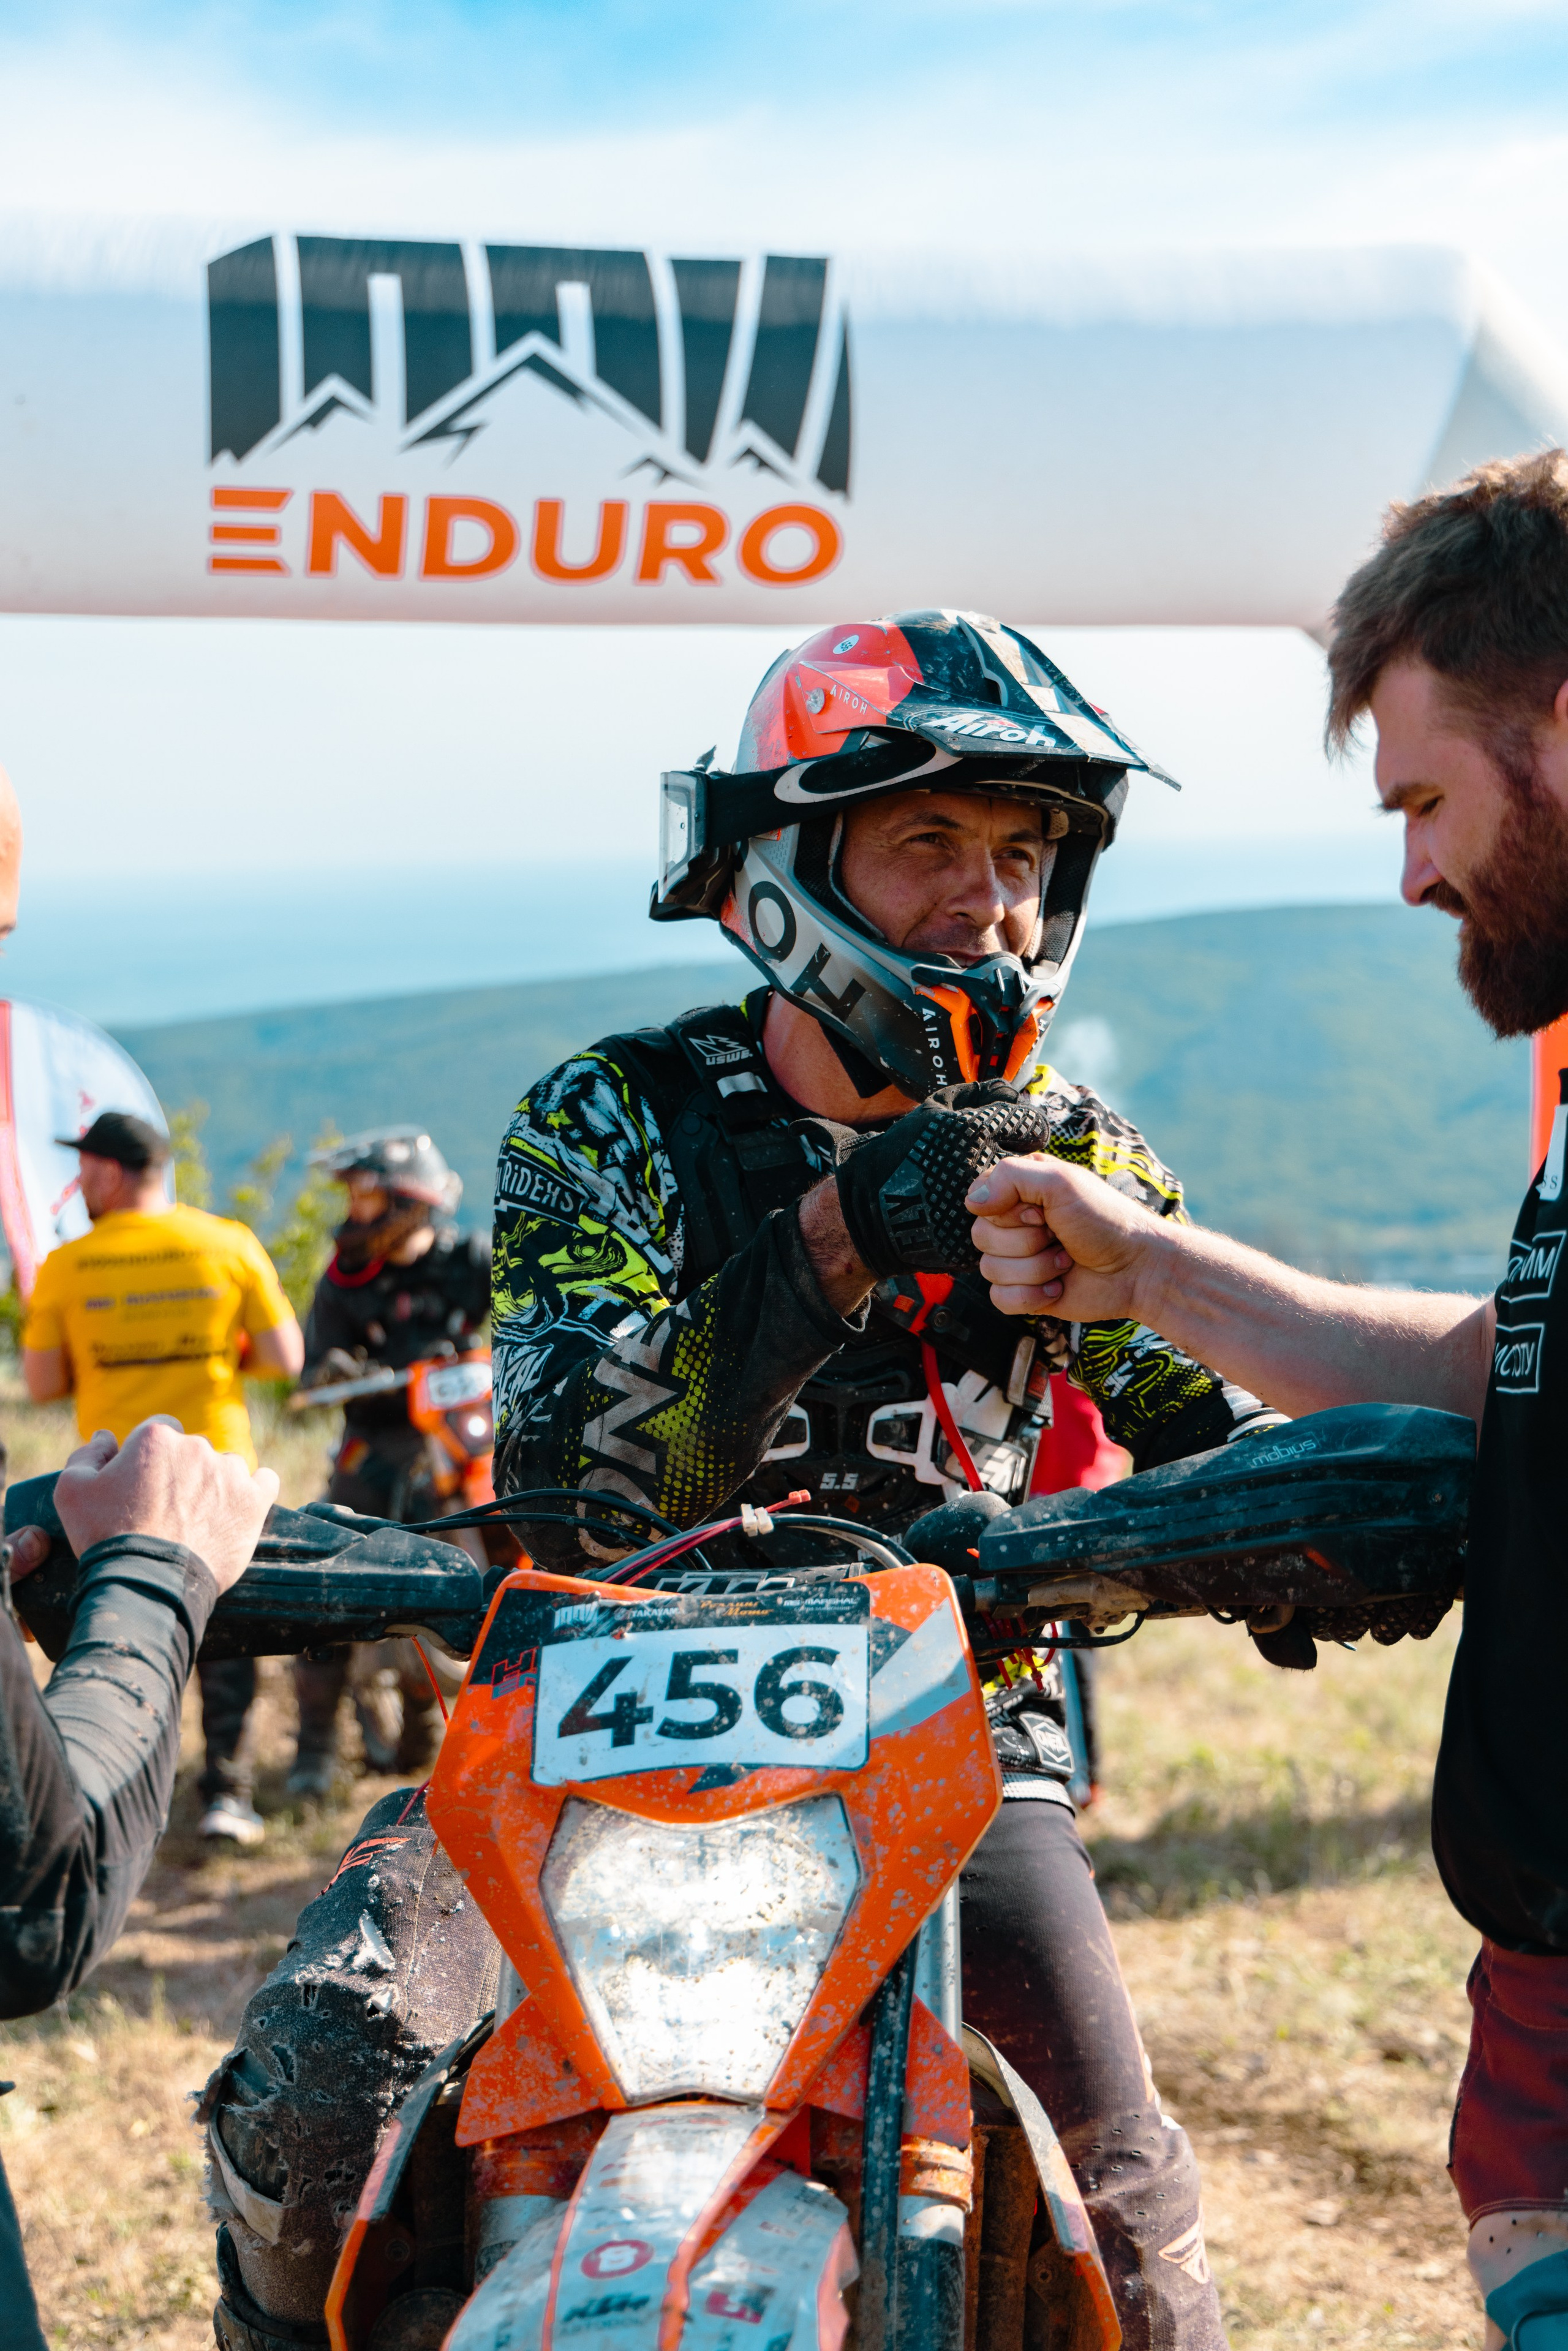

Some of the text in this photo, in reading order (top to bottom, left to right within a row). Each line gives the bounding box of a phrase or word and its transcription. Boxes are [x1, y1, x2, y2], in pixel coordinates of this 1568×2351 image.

[207, 485, 844, 589] ENDURO
[829, 684, 869, 715] AIROH
[918, 712, 1057, 747] Airoh
[922, 1007, 948, 1085] AIROH
[884, 1194, 937, 1255] FLY
[1252, 1440, 1316, 1466] mobius
[820, 1473, 859, 1490] 5.5
[557, 1645, 845, 1748] 456
